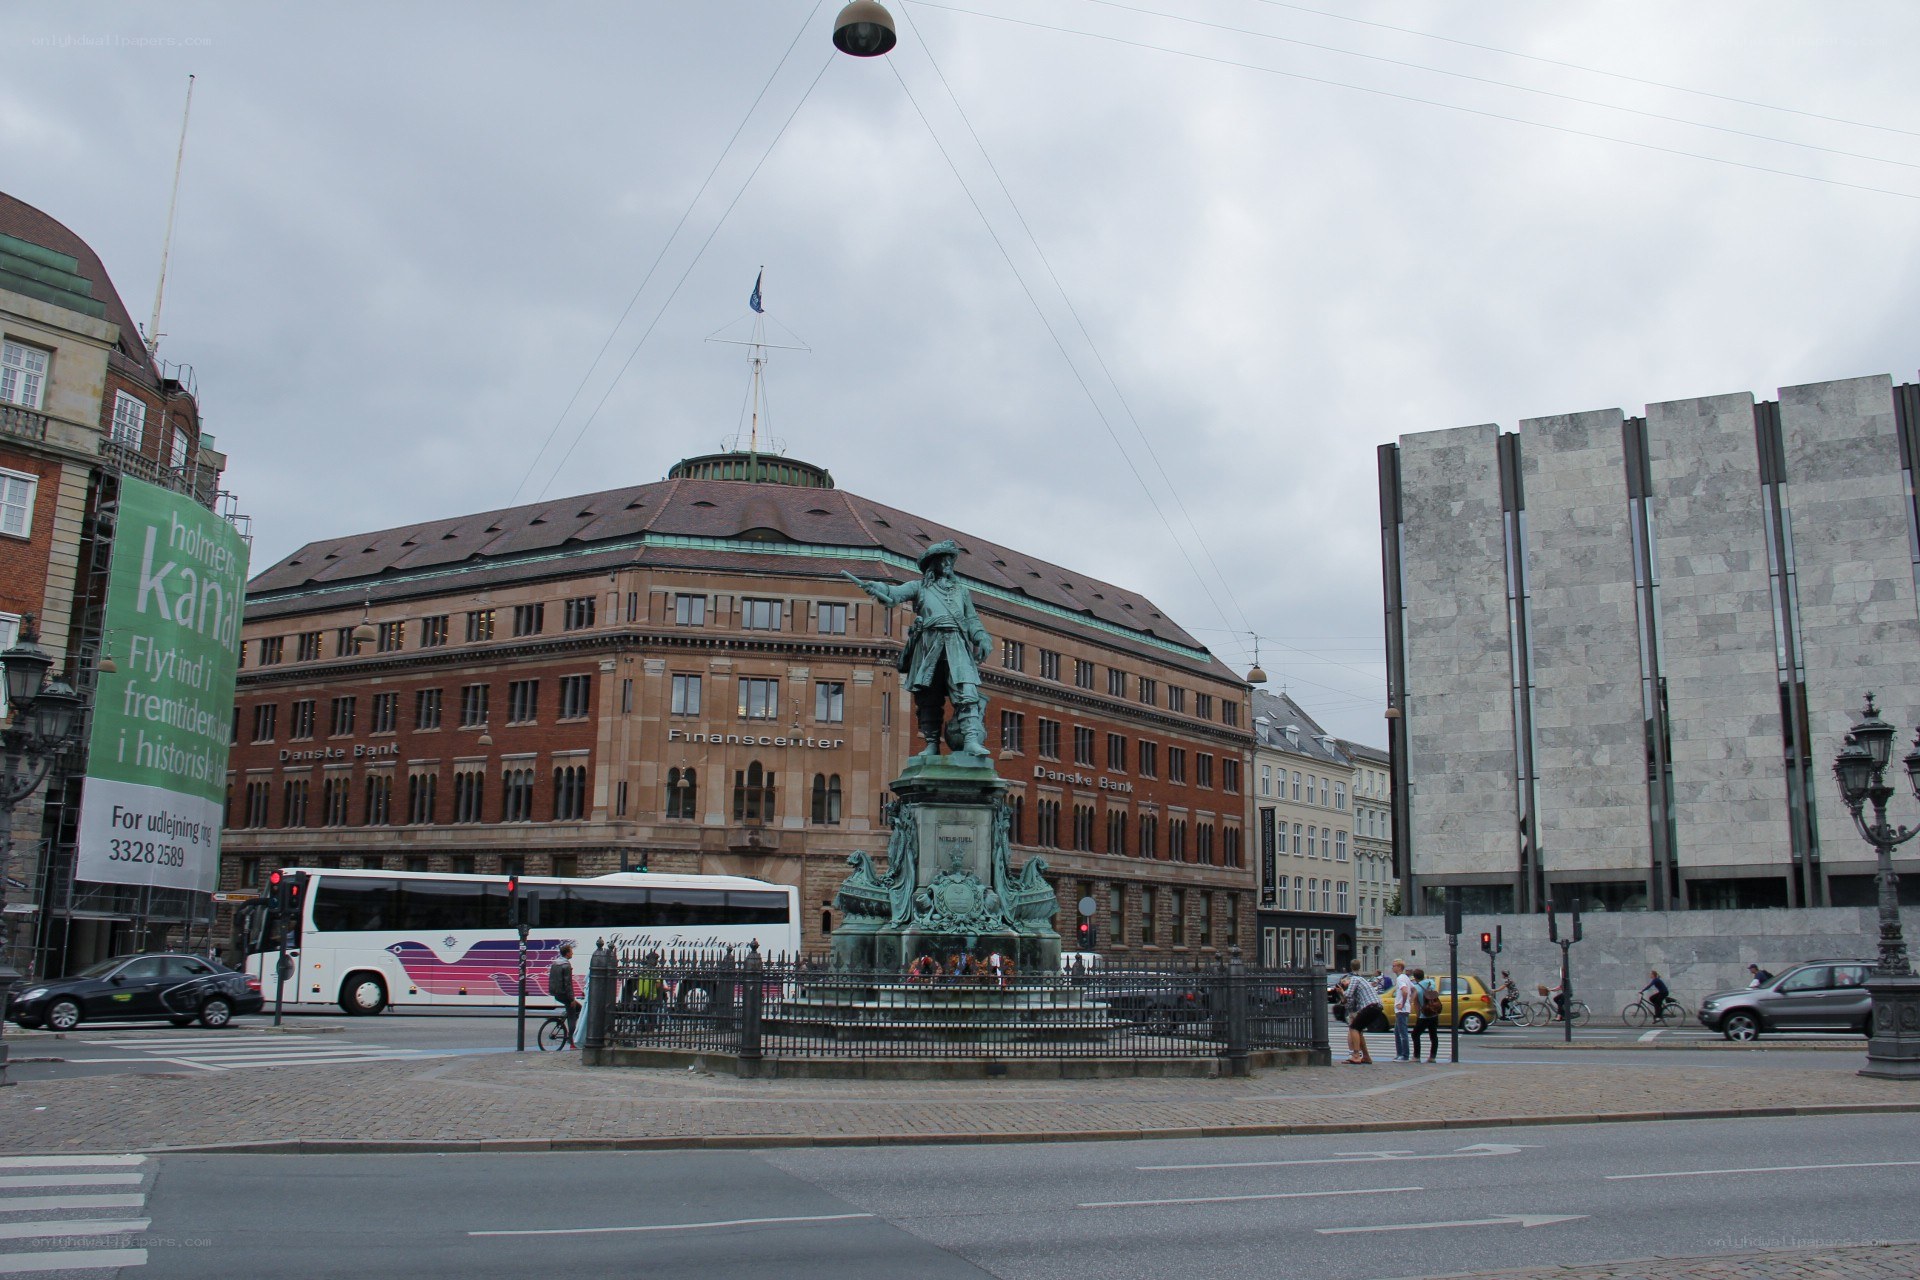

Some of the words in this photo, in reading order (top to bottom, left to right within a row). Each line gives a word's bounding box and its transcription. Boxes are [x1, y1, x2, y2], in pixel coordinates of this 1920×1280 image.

[136, 525, 241, 654] kanal
[129, 634, 177, 683] Flyt
[177, 649, 204, 689] ind
[205, 660, 213, 692] i
[117, 728, 126, 763] i
[279, 746, 346, 762] Danske
[353, 741, 401, 757] Bank
[668, 729, 844, 748] Finanscenter
[1033, 765, 1093, 786] Danske
[1098, 776, 1134, 793] Bank
[112, 805, 143, 830] For
[147, 810, 200, 844] udlejning
[109, 839, 155, 863] 3328
[157, 844, 184, 867] 2589
[607, 932, 662, 951] Sydthy
